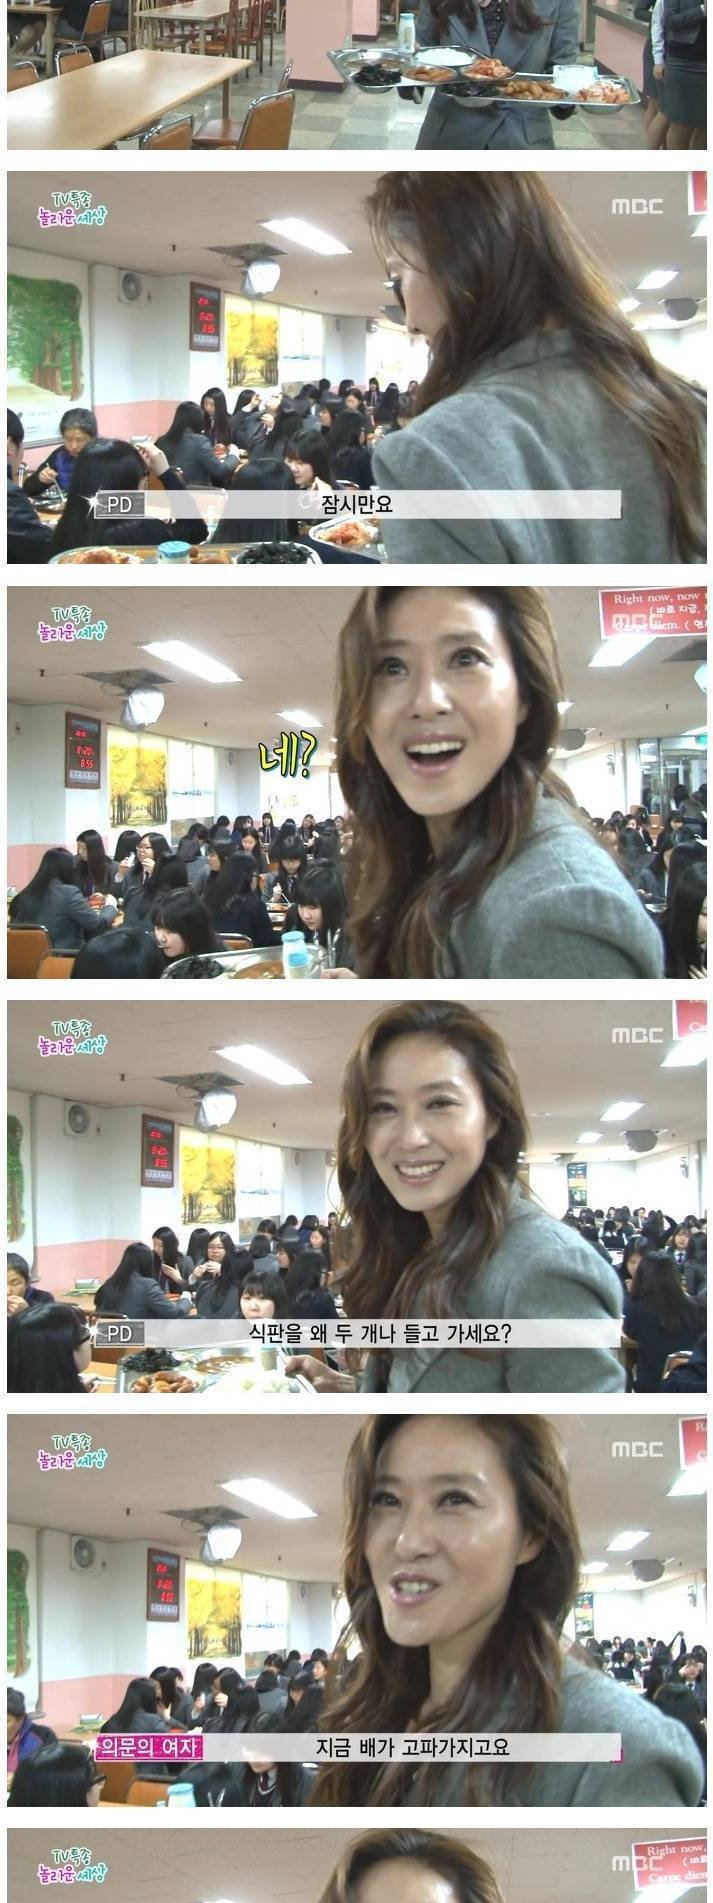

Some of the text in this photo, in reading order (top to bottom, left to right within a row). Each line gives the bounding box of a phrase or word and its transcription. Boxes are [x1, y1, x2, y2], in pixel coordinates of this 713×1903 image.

[614, 592, 700, 605] Right now, now
[647, 1845, 676, 1857] Right
[648, 1873, 682, 1884] Carpe
